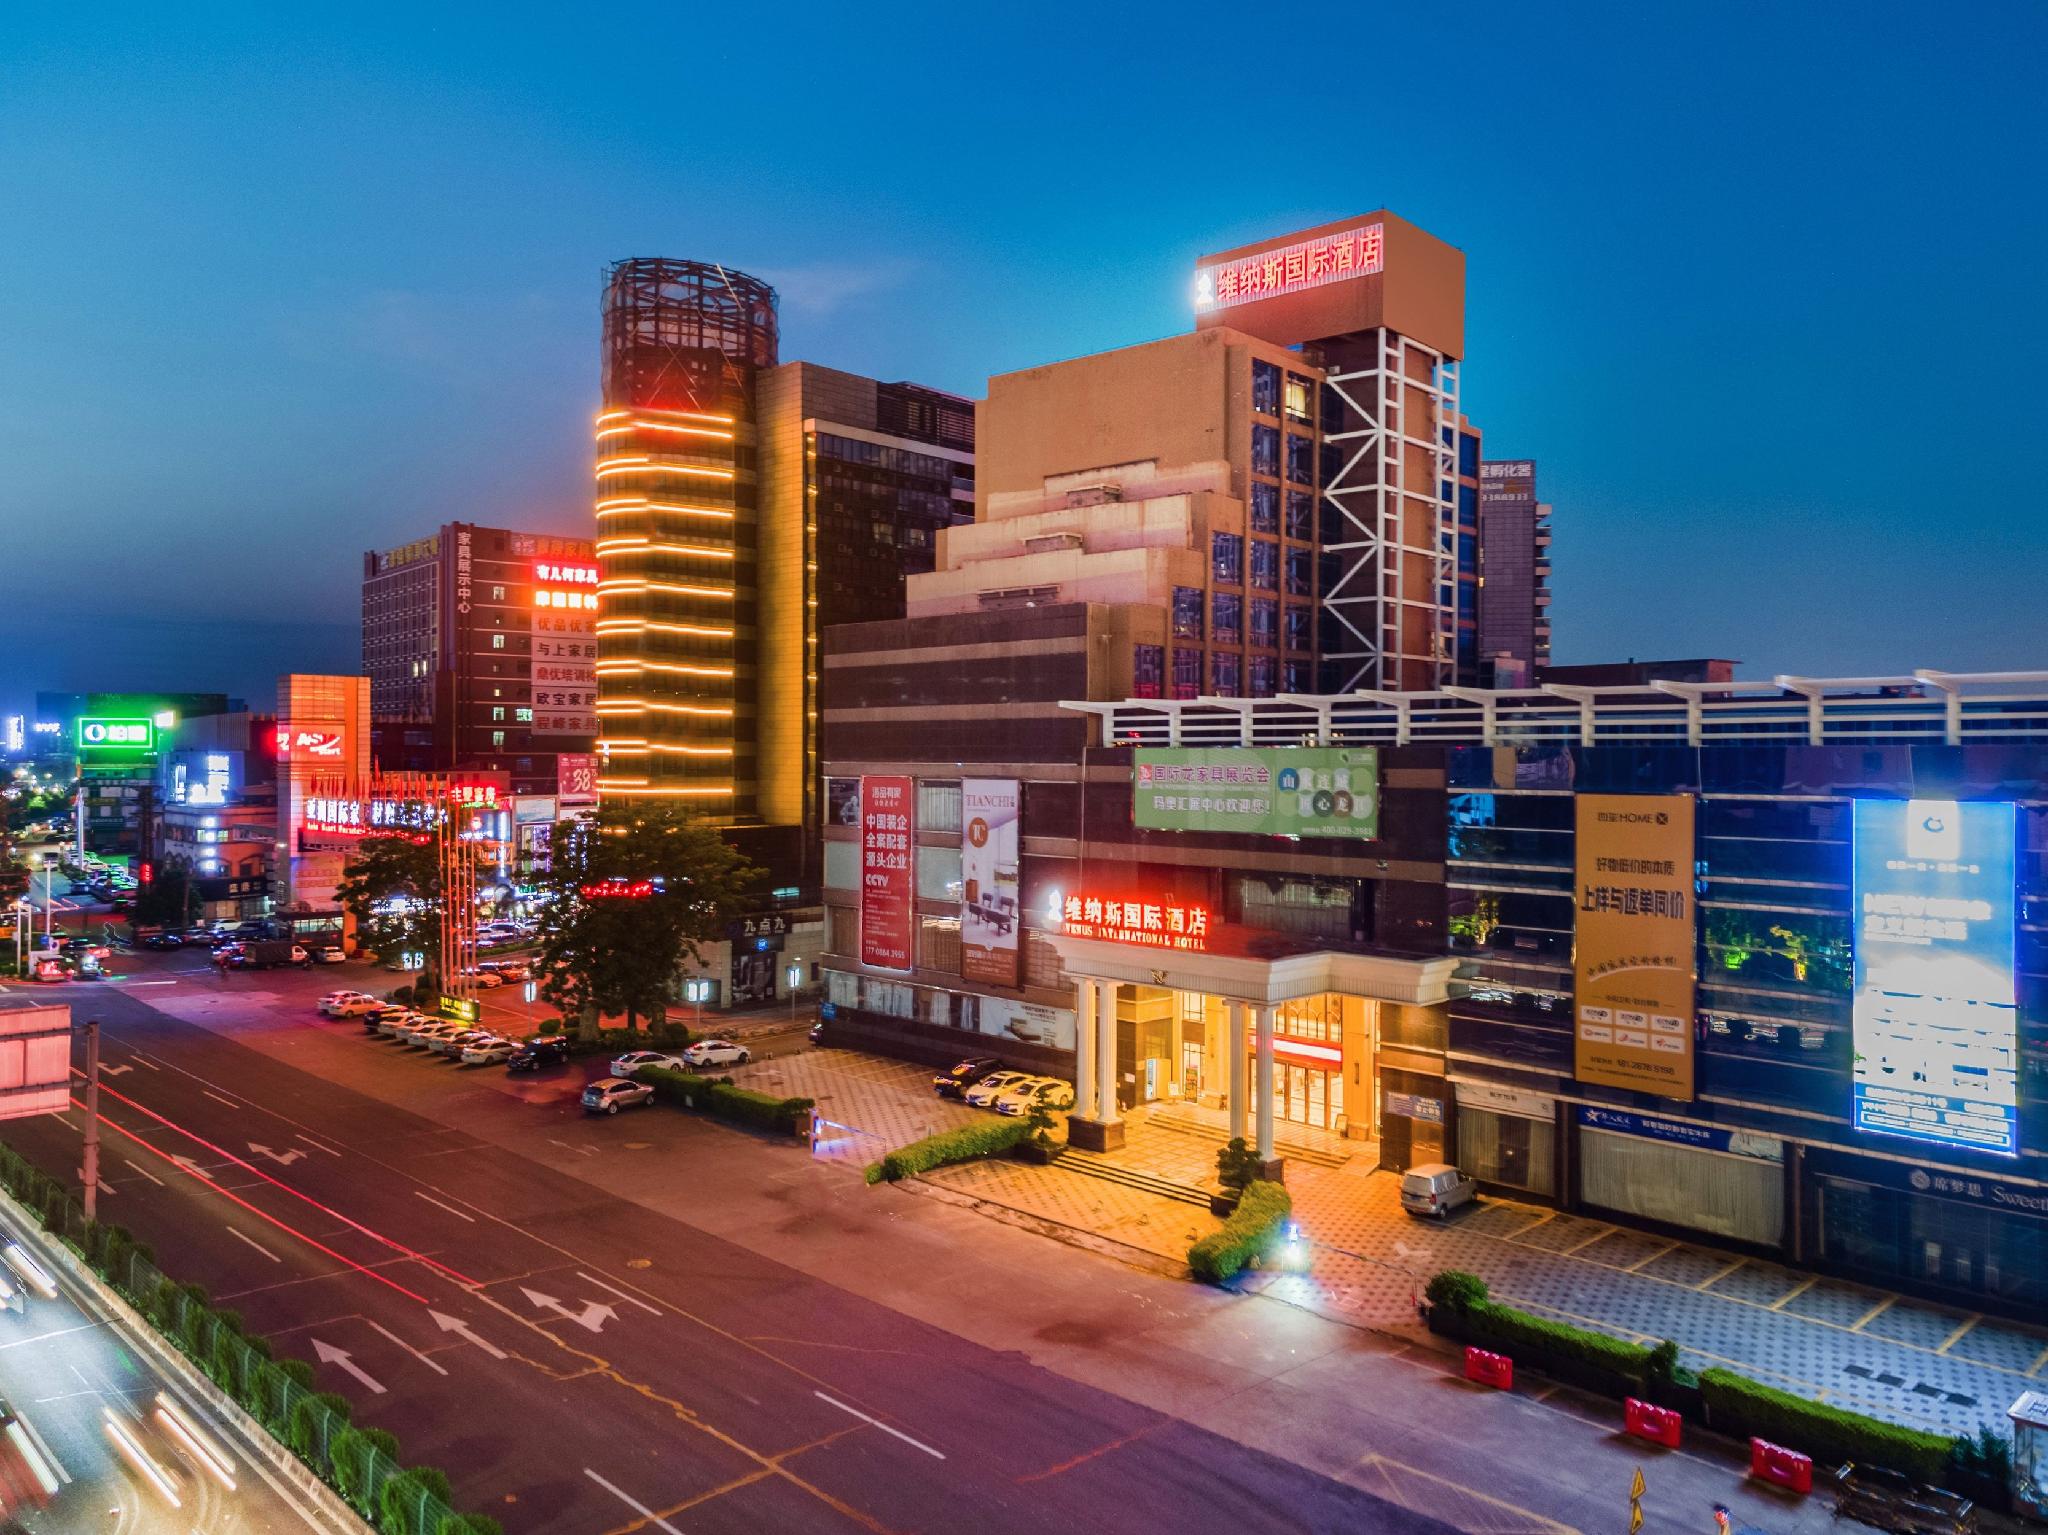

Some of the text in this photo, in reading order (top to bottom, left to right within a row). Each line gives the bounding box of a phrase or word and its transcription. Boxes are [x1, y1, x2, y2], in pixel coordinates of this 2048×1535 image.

[1217, 229, 1383, 302] 维纳斯国际酒店
[457, 531, 472, 614] 家具展示中心
[866, 832, 908, 850] 全案配套
[866, 851, 907, 869] 源头企业
[865, 873, 889, 887] CCTV
[744, 916, 786, 932] 九点九
[1064, 895, 1207, 936] 维纳斯国际酒店
[1065, 923, 1206, 951] VENUS INTERNATIONAL HOTEL
